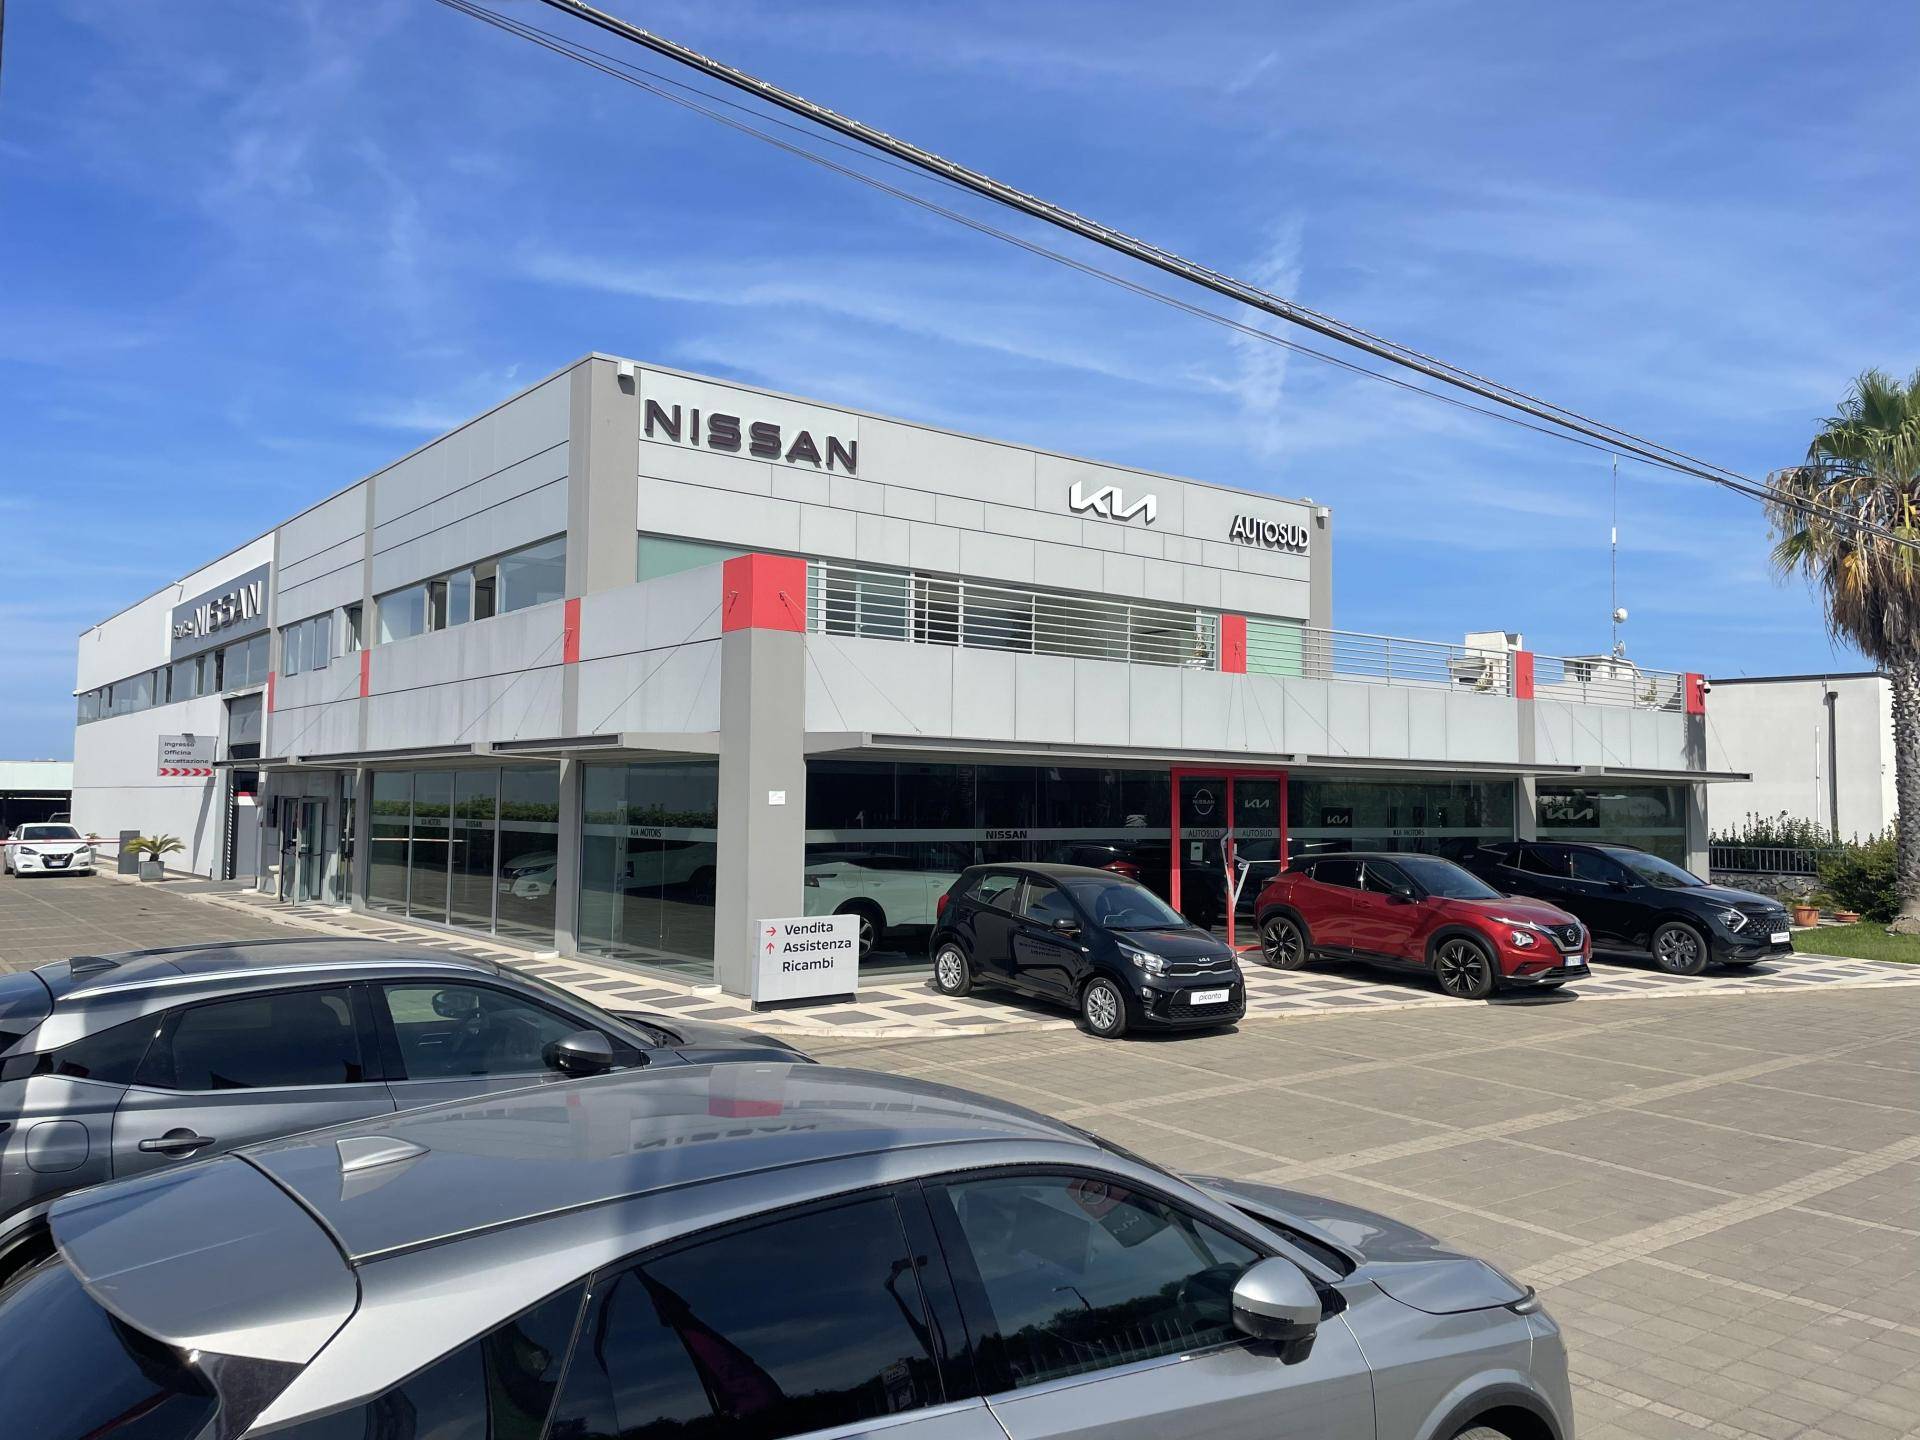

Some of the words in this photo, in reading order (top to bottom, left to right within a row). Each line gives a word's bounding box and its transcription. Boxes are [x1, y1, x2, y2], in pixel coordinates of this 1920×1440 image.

[645, 399, 857, 474] NISSAN
[1069, 480, 1156, 525] KIA
[1230, 515, 1309, 550] AUTOSUD
[194, 581, 262, 638] NISSAN
[1326, 814, 1349, 825] KIA
[1546, 807, 1594, 820] KIA
[640, 828, 662, 838] MOTORS
[985, 830, 1028, 840] NISSAN
[1188, 829, 1220, 838] AUTOSUD
[1242, 829, 1273, 837] AUTOSUD
[784, 922, 834, 936] Vendita
[783, 939, 852, 953] Assistenza
[782, 956, 834, 972] Ricambi
